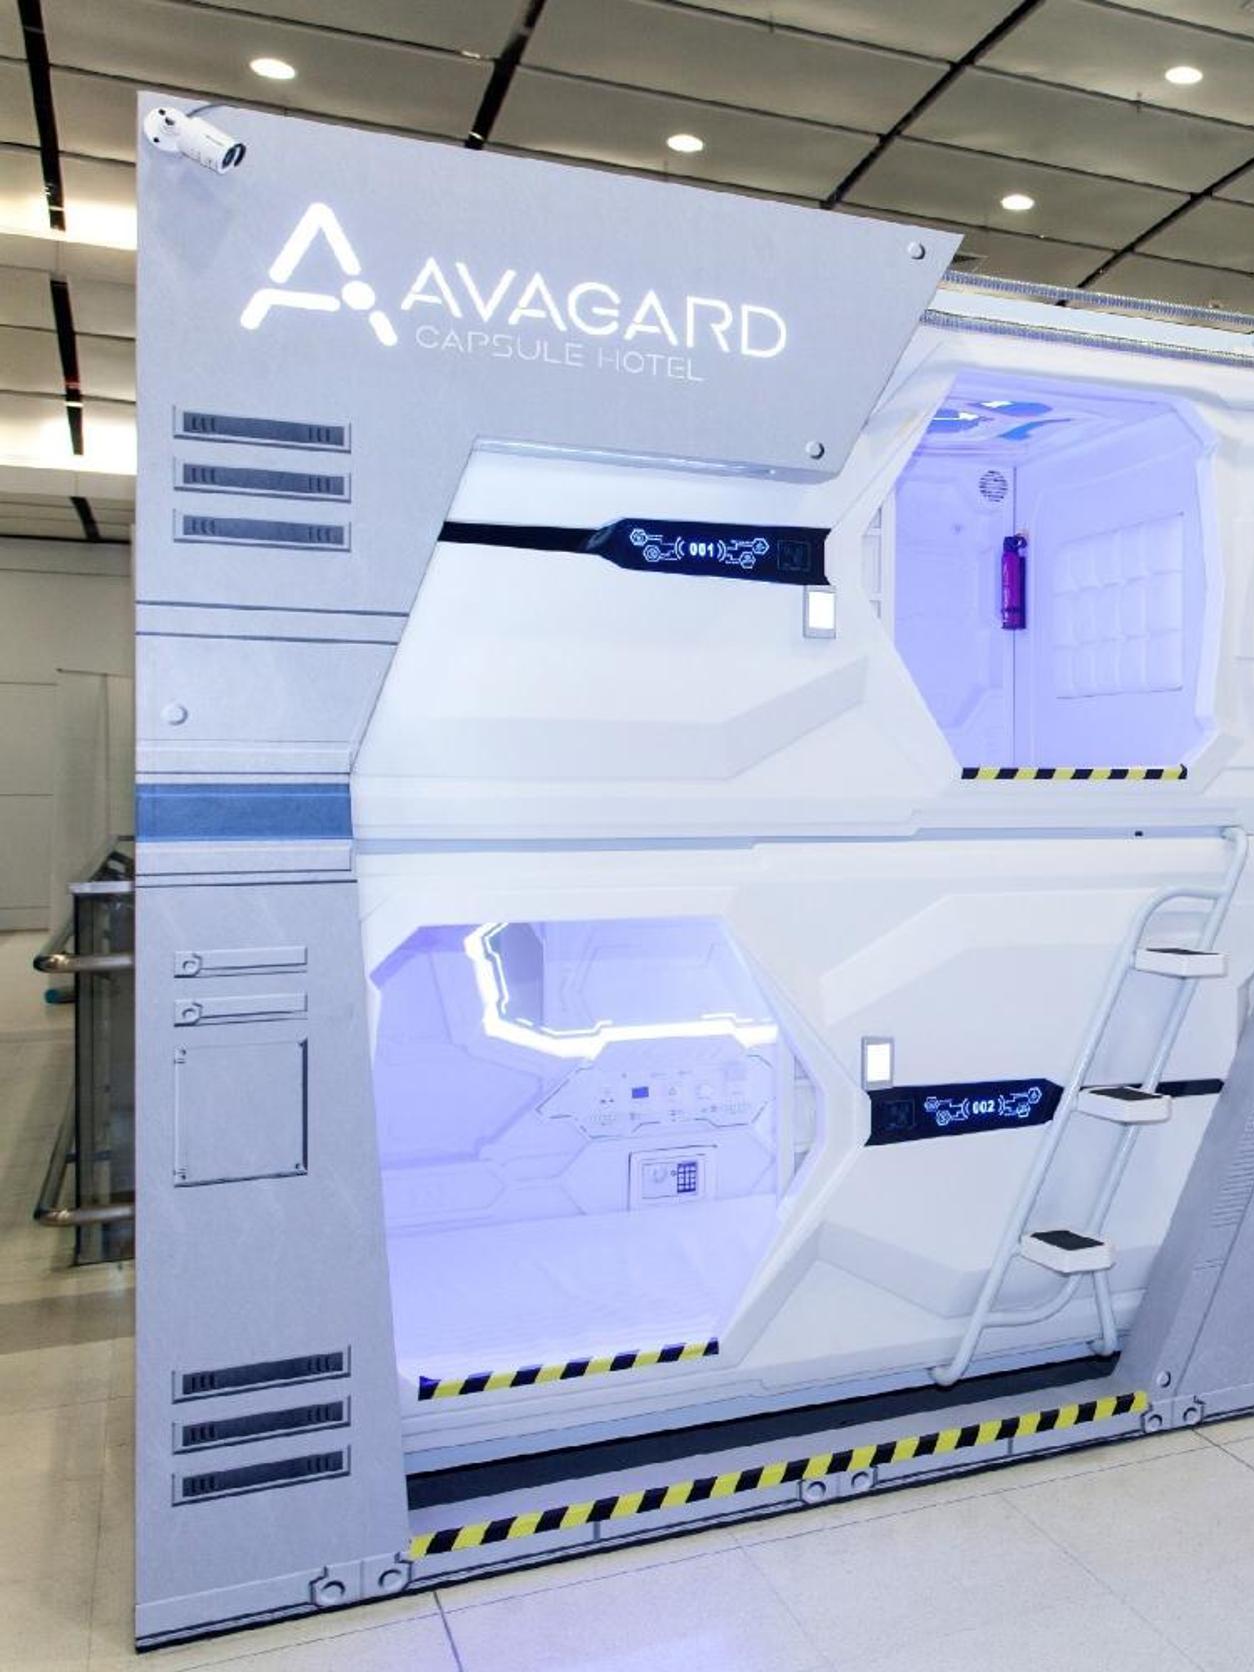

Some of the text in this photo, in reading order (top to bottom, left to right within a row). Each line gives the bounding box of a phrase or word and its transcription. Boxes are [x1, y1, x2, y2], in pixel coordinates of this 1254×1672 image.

[400, 256, 787, 358] AVAGARD
[415, 323, 704, 382] CAPSULE HOTEL
[689, 542, 714, 557] 001
[972, 1100, 996, 1114] 002
